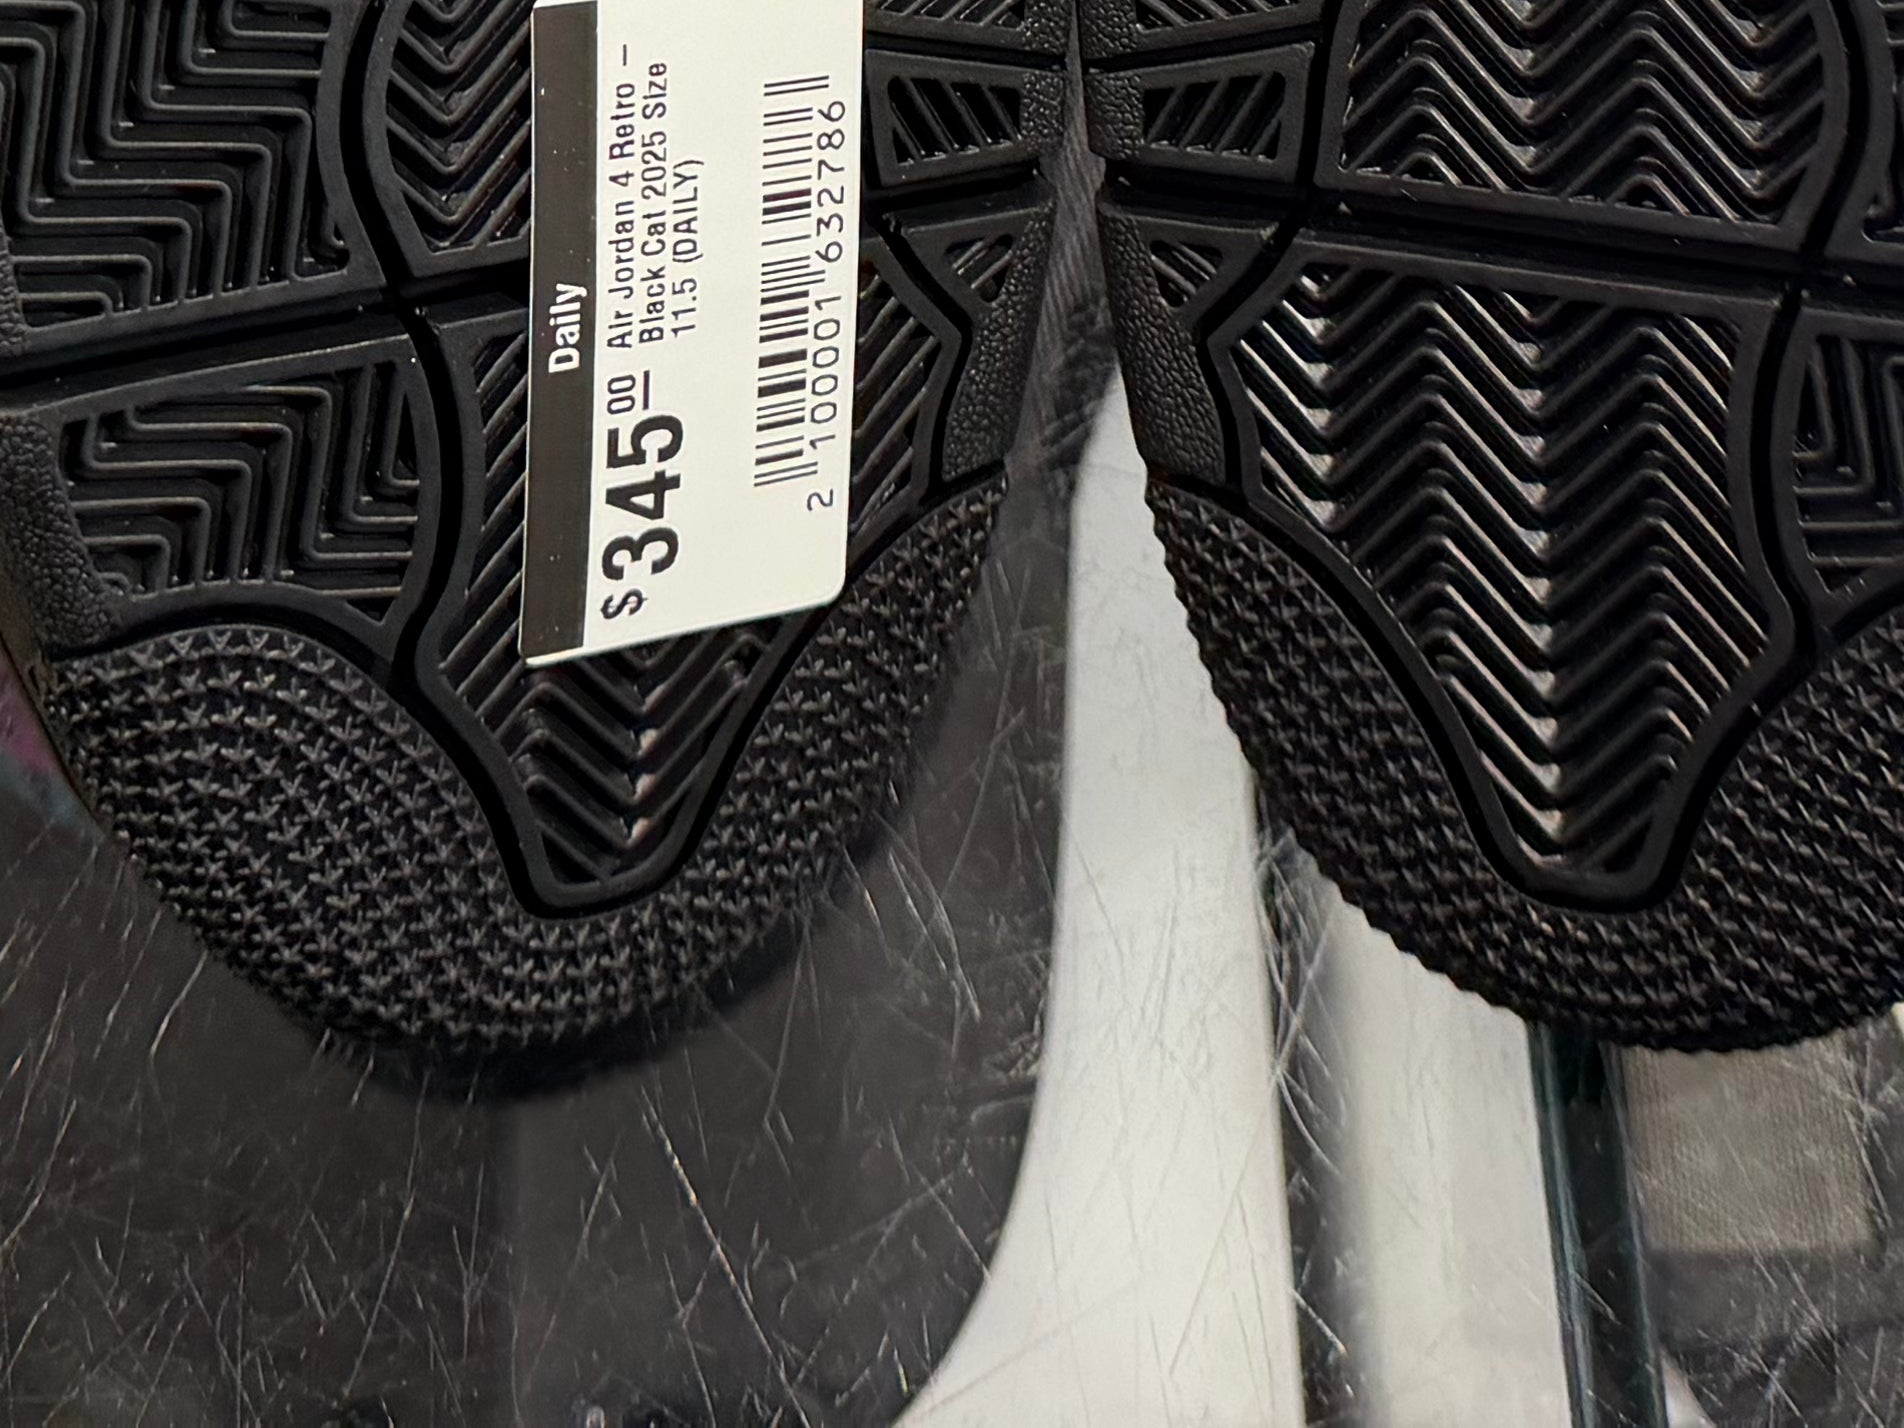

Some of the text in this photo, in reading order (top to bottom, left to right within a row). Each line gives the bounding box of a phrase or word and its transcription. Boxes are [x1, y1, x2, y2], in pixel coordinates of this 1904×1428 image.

[608, 83, 635, 160] Retro
[608, 171, 634, 187] 4
[815, 101, 846, 263] 632786
[607, 200, 635, 300] Jordan
[638, 63, 667, 344] Black Cat 2025 Size
[670, 159, 704, 337] 11.5 (DAILY)
[548, 282, 589, 375] Daily
[606, 310, 634, 350] Air
[809, 296, 841, 450] 100001
[599, 413, 685, 621] $345
